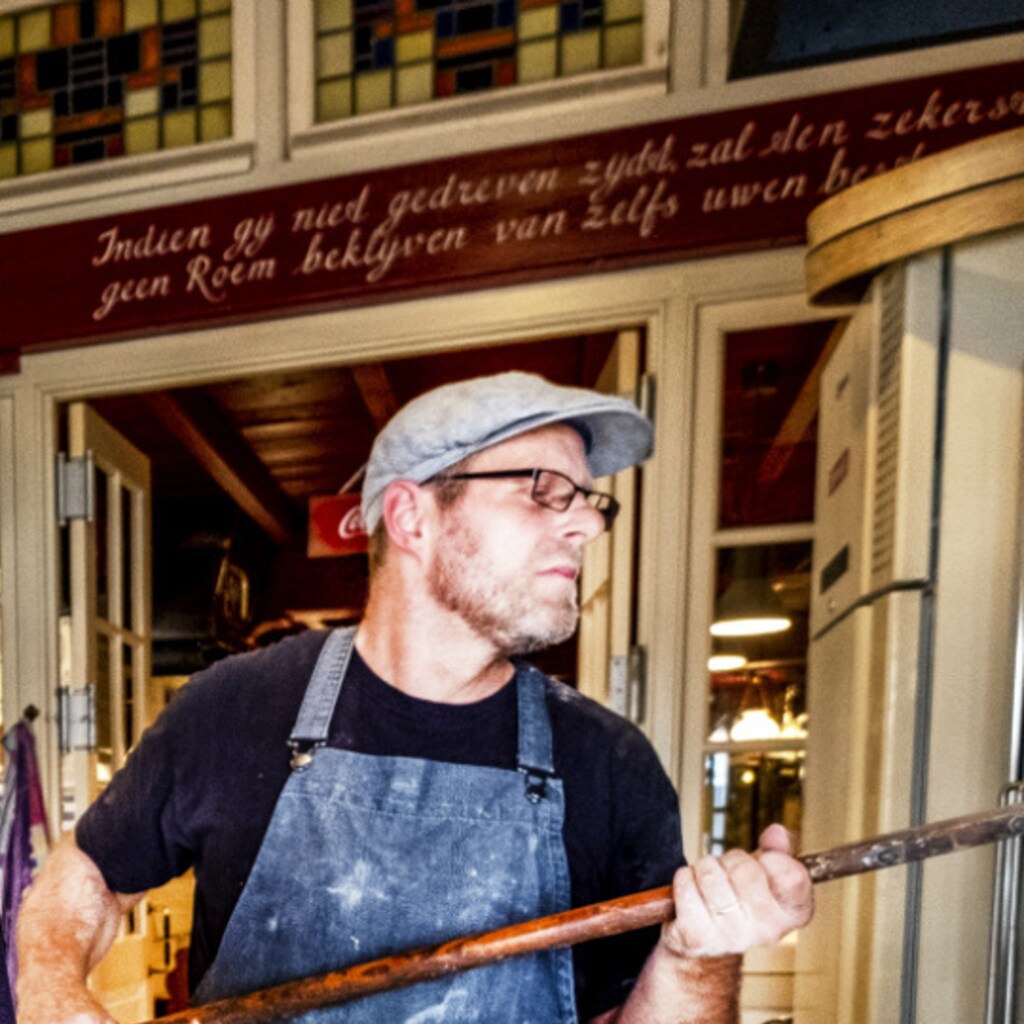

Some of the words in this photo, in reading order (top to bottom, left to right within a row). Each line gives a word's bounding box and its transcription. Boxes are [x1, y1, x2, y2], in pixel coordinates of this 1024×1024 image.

[92, 224, 211, 267] Indien
[376, 169, 559, 236] gedreven
[686, 121, 757, 168] zal
[92, 275, 171, 322] geen
[186, 254, 276, 304] Roem
[495, 209, 569, 244] van
[580, 179, 679, 238] zelfs
[703, 174, 808, 213] uwen
